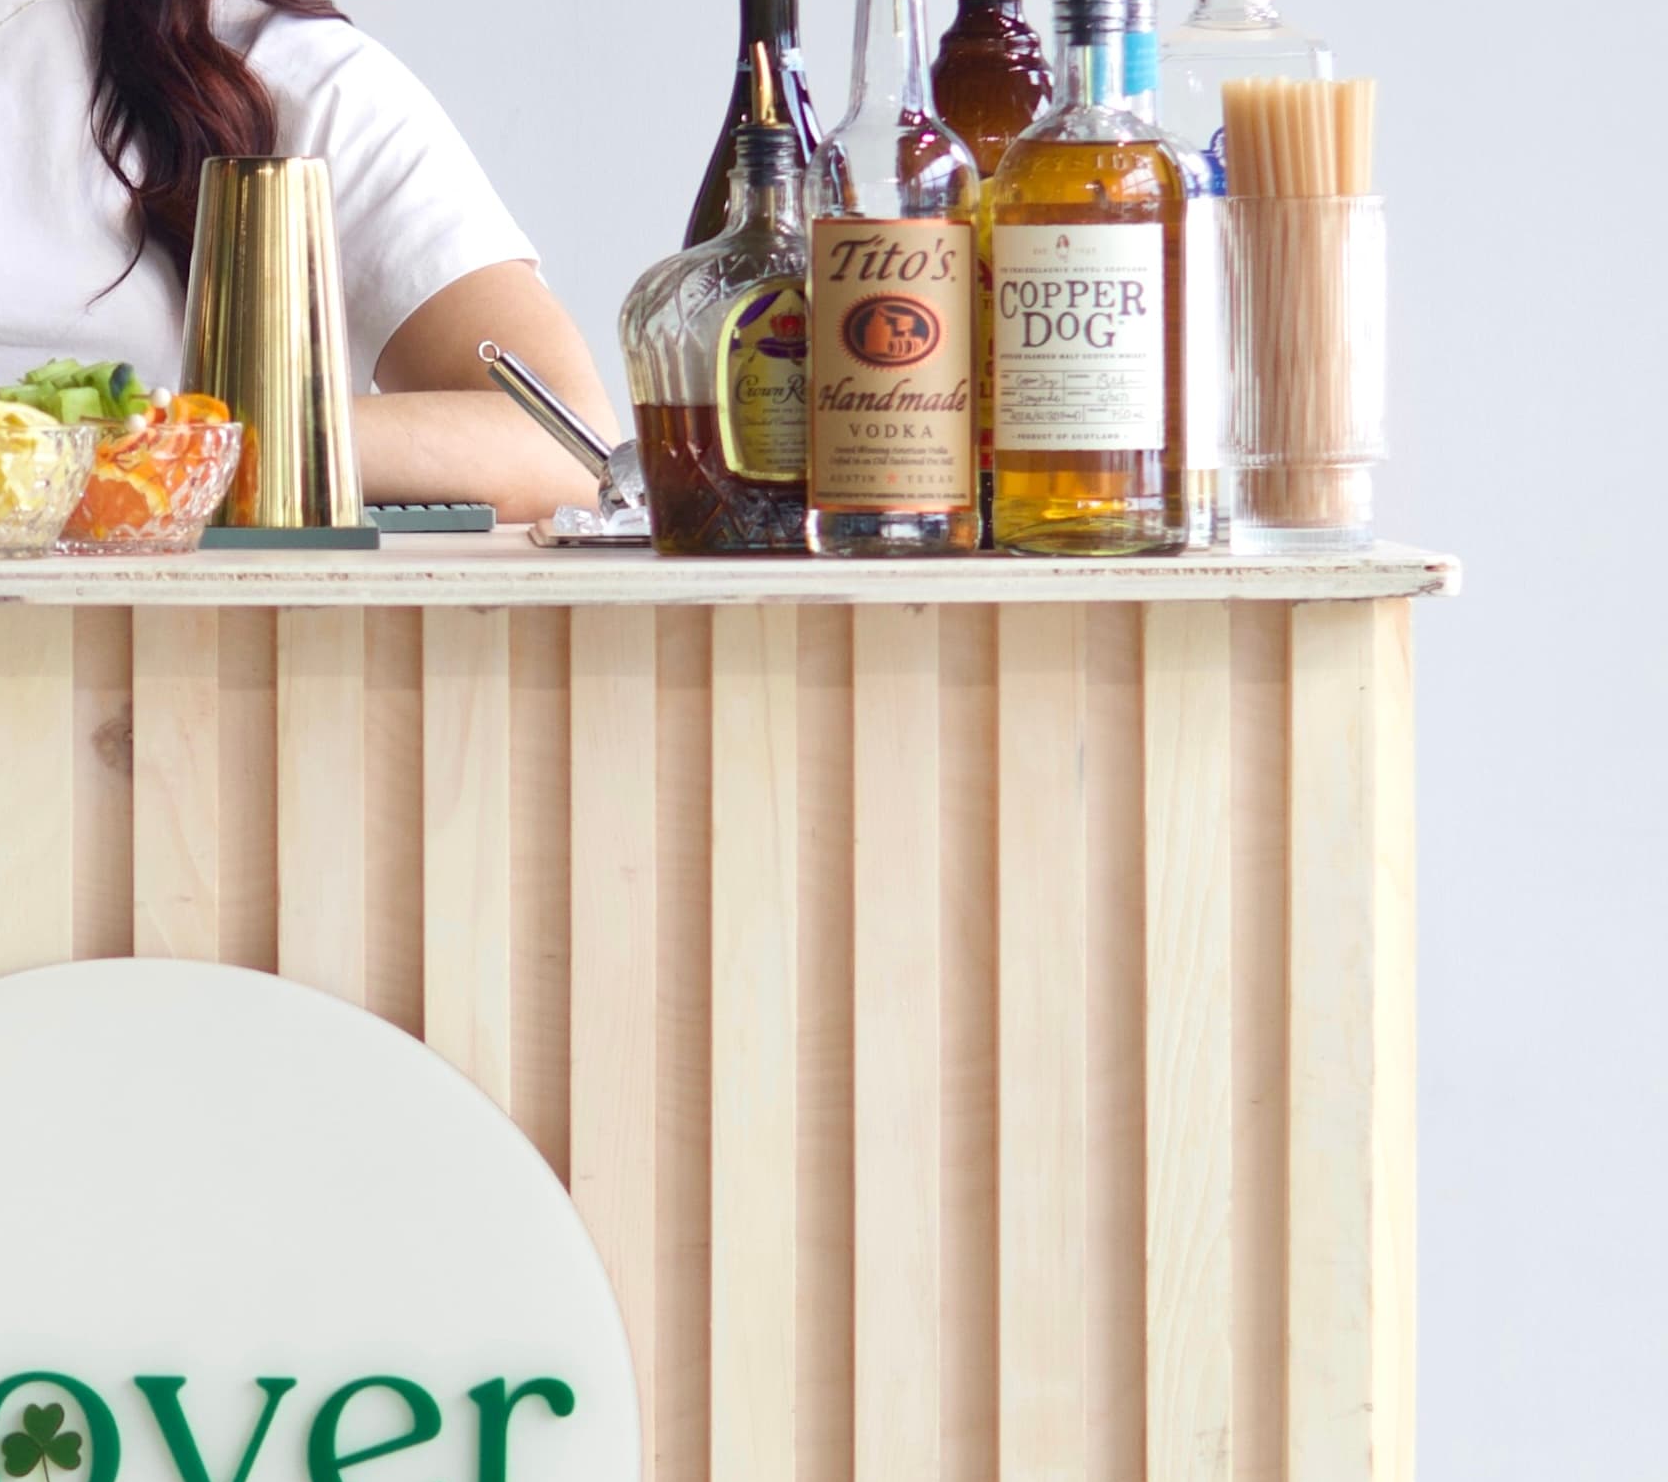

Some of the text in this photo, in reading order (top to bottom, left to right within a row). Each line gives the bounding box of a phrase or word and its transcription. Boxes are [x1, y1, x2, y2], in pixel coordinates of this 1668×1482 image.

[1000, 280, 1146, 319] COPPER
[1022, 311, 1116, 348] DOG
[735, 374, 784, 405] Crown
[818, 376, 968, 412] Handmade
[849, 424, 933, 438] VODKA
